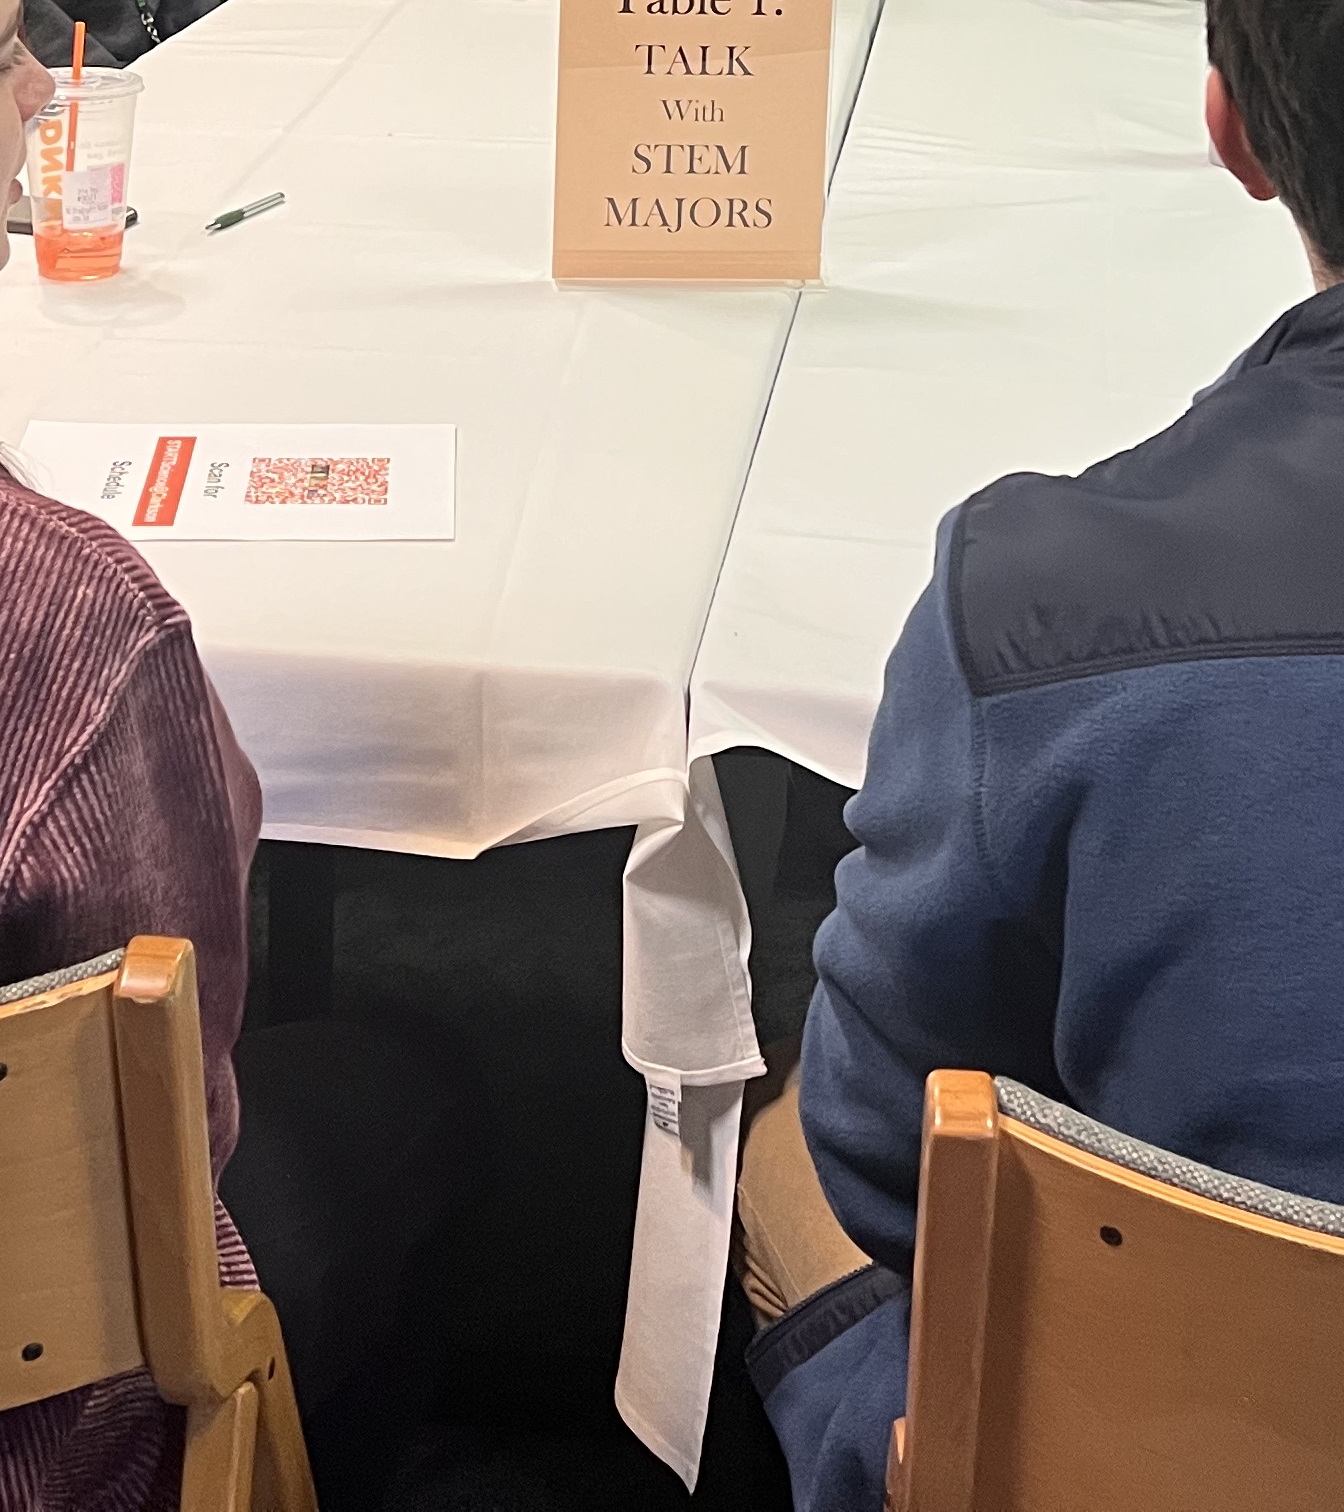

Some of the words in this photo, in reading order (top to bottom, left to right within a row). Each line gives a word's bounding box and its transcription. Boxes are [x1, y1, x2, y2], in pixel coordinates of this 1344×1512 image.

[635, 43, 754, 77] TALK
[660, 99, 725, 123] With
[631, 142, 749, 175] STEM
[604, 196, 773, 234] MAJORS
[100, 460, 133, 500] Schedule
[207, 462, 230, 484] Scan
